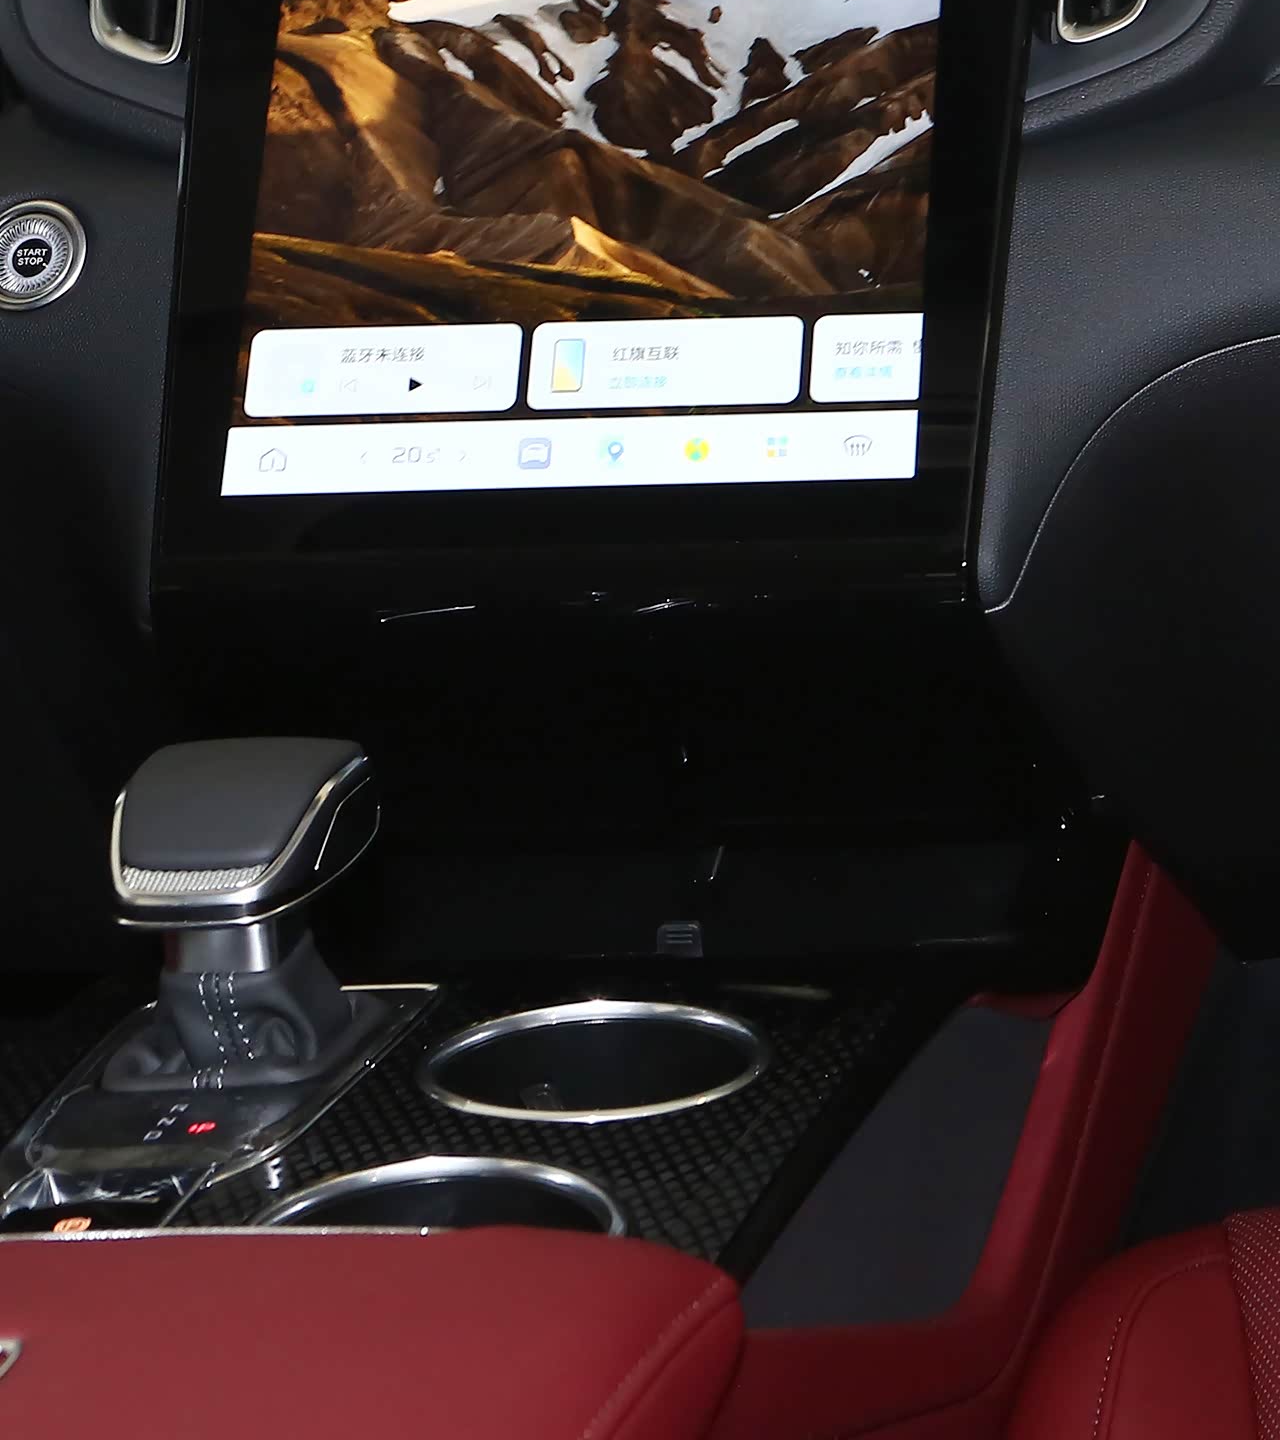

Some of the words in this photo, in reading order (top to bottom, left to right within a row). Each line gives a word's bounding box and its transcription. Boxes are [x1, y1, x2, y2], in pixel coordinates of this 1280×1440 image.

[16, 248, 48, 257] START
[17, 257, 44, 266] STOP
[340, 346, 426, 363] 蓝牙未连接
[612, 344, 681, 361] 红旗互联
